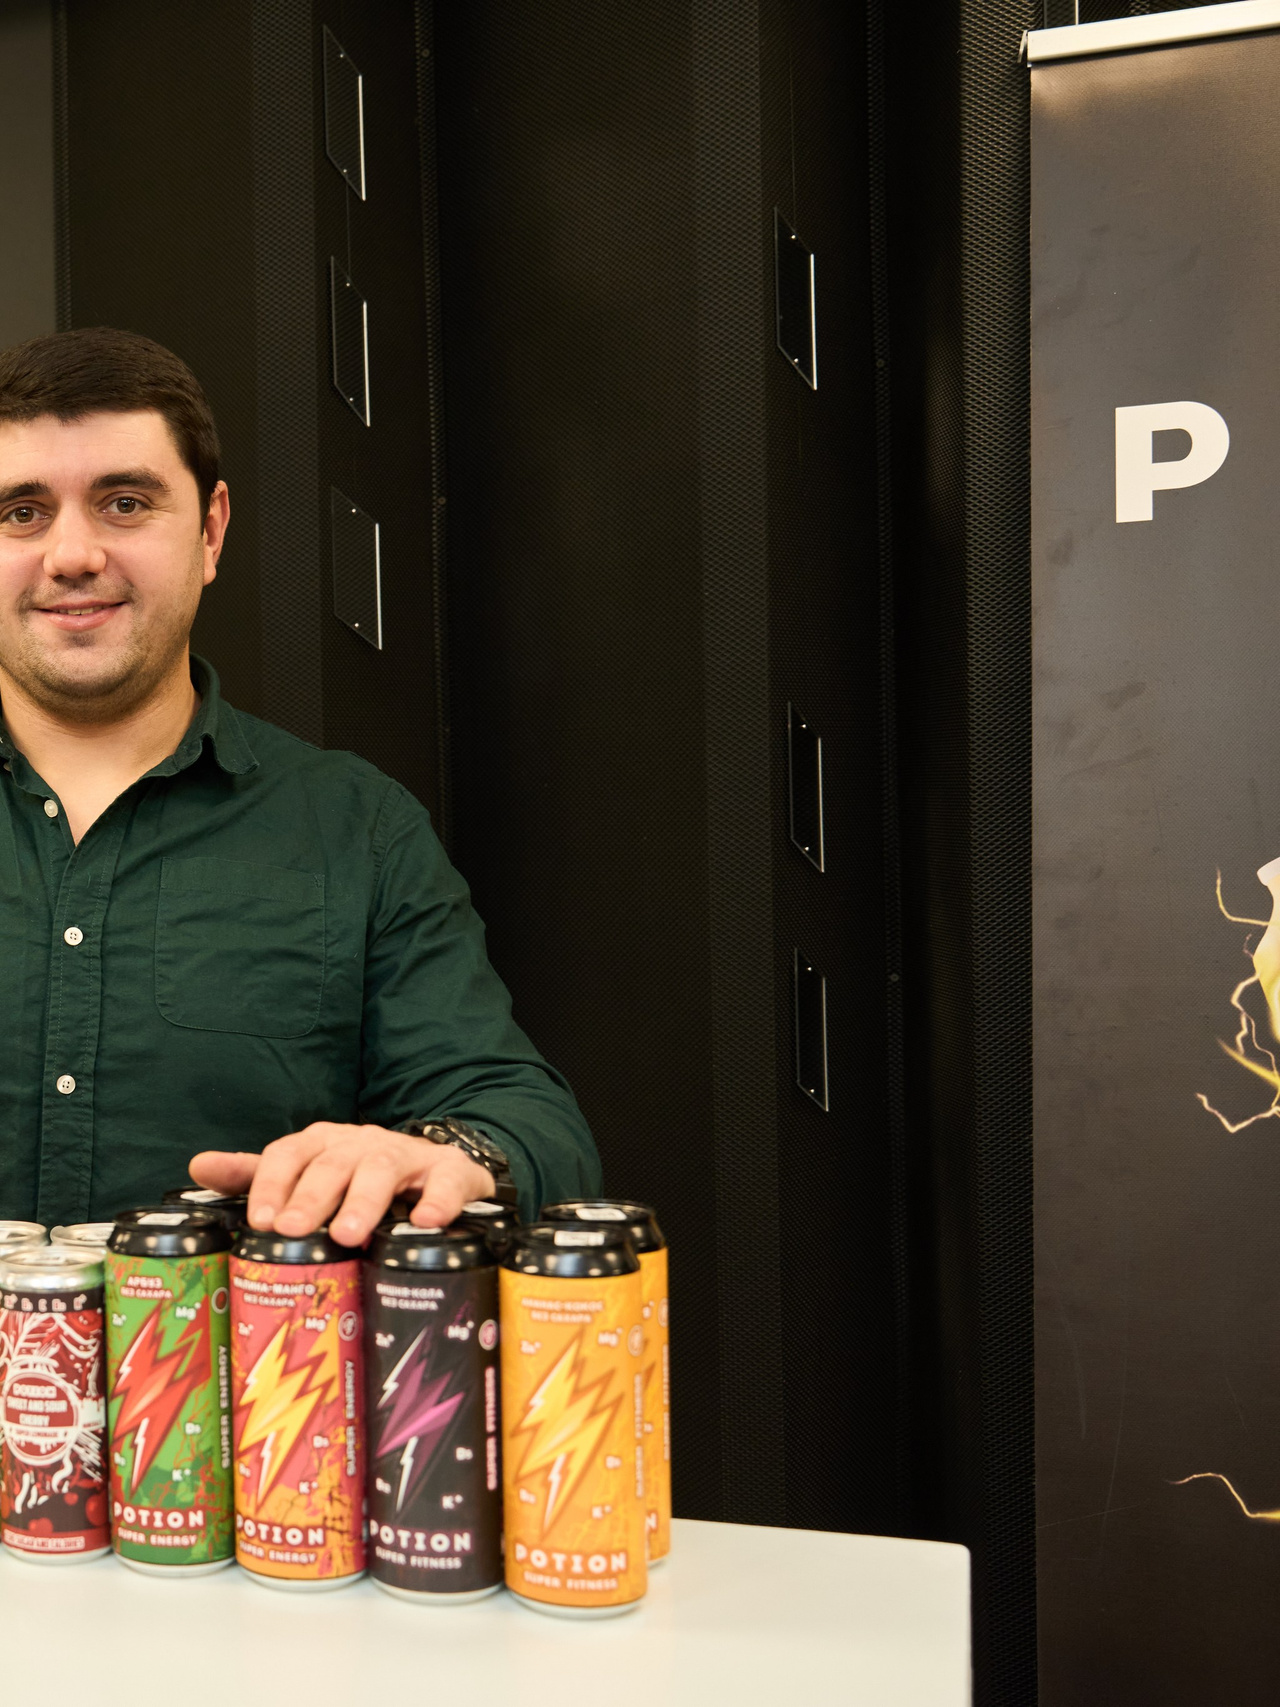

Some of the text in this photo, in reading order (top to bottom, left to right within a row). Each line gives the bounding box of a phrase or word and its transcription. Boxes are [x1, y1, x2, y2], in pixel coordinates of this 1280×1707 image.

[1115, 401, 1230, 524] P
[218, 1345, 231, 1470] SUPER ENERGY
[344, 1360, 357, 1477] SUPER ENERGY
[114, 1502, 204, 1527] POTION
[118, 1526, 198, 1547] SUPER ENERGY
[236, 1515, 325, 1545] POTION
[370, 1519, 472, 1552] POTION
[239, 1541, 318, 1564] SUPER ENERGY
[375, 1546, 462, 1570] SUPER FITNESS
[515, 1543, 628, 1574] POTION
[524, 1569, 619, 1591] SUPER FITNESS
